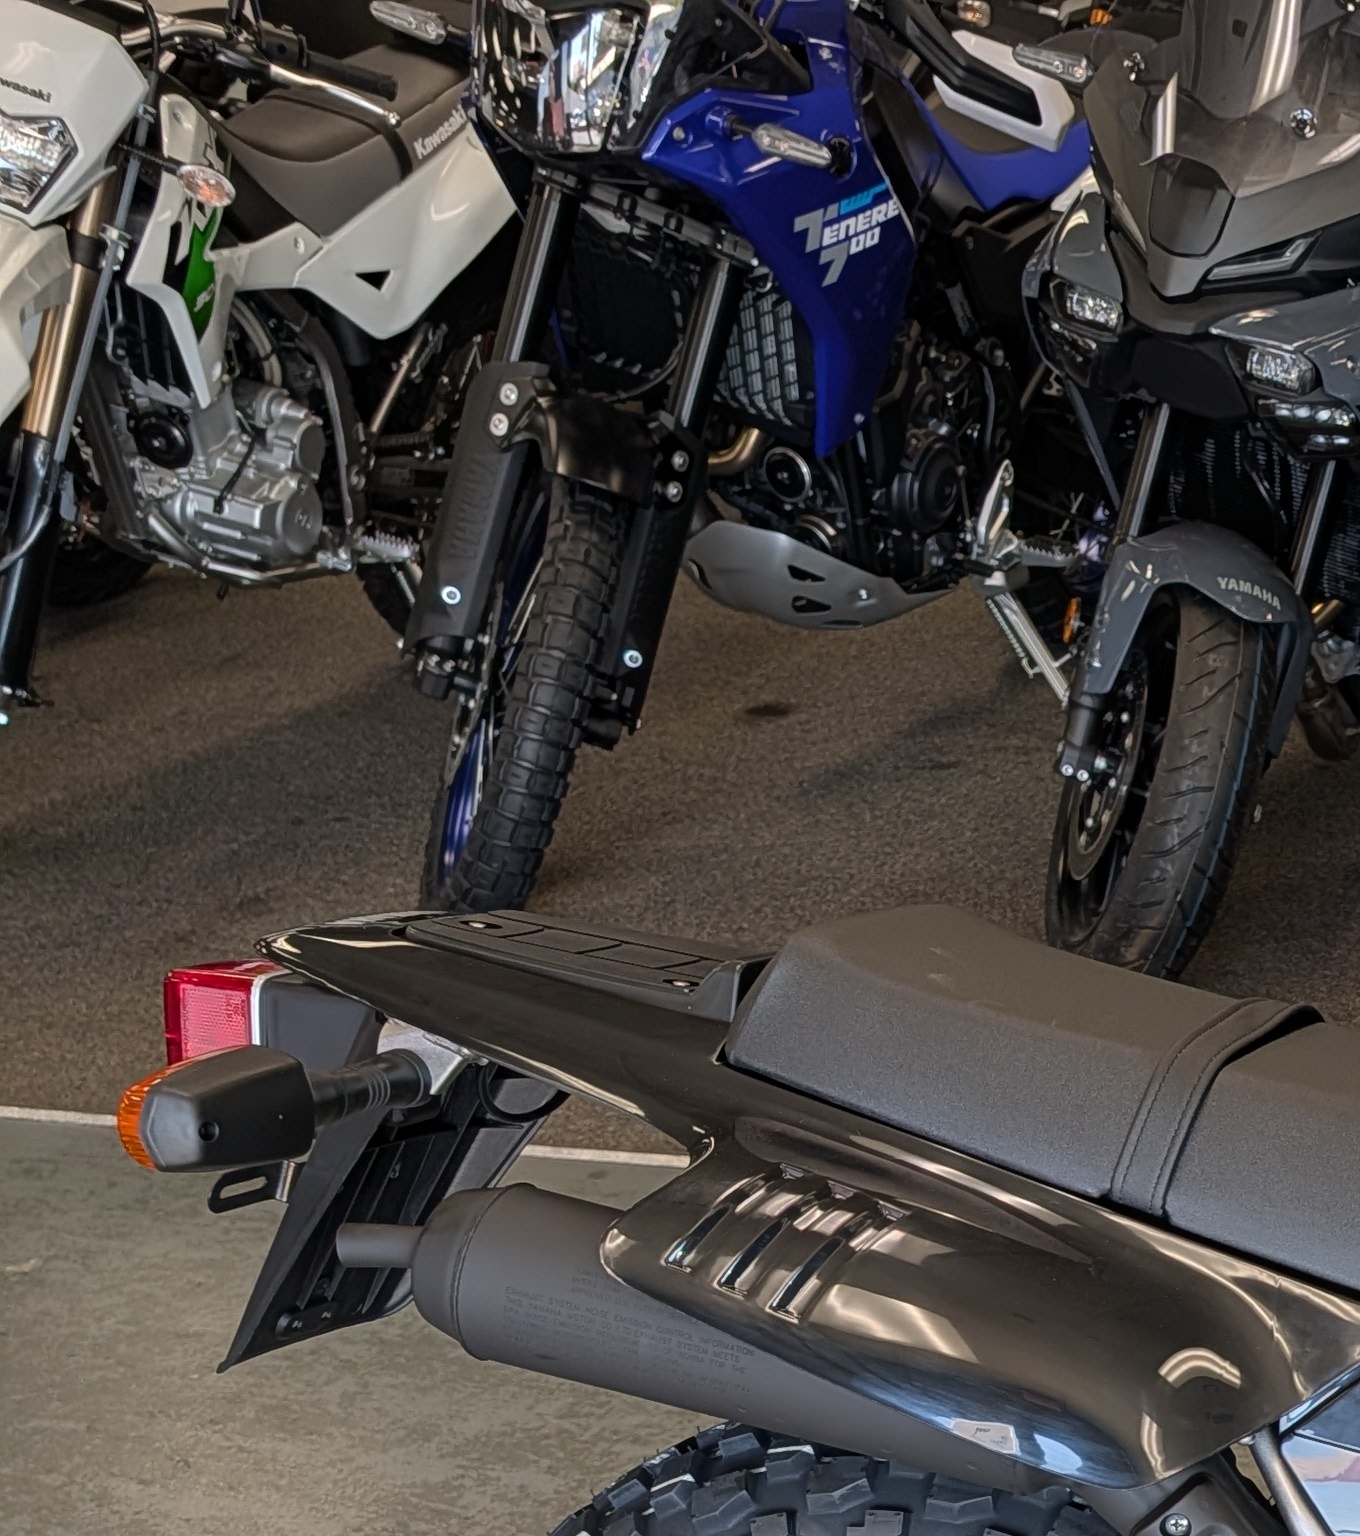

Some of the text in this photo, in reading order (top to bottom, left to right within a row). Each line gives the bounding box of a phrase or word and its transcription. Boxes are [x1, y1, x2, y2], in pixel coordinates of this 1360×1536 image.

[413, 103, 467, 159] Kawasaki
[818, 226, 881, 288] 700
[1216, 576, 1281, 611] YAMAHA
[549, 1297, 583, 1313] SYSTEM
